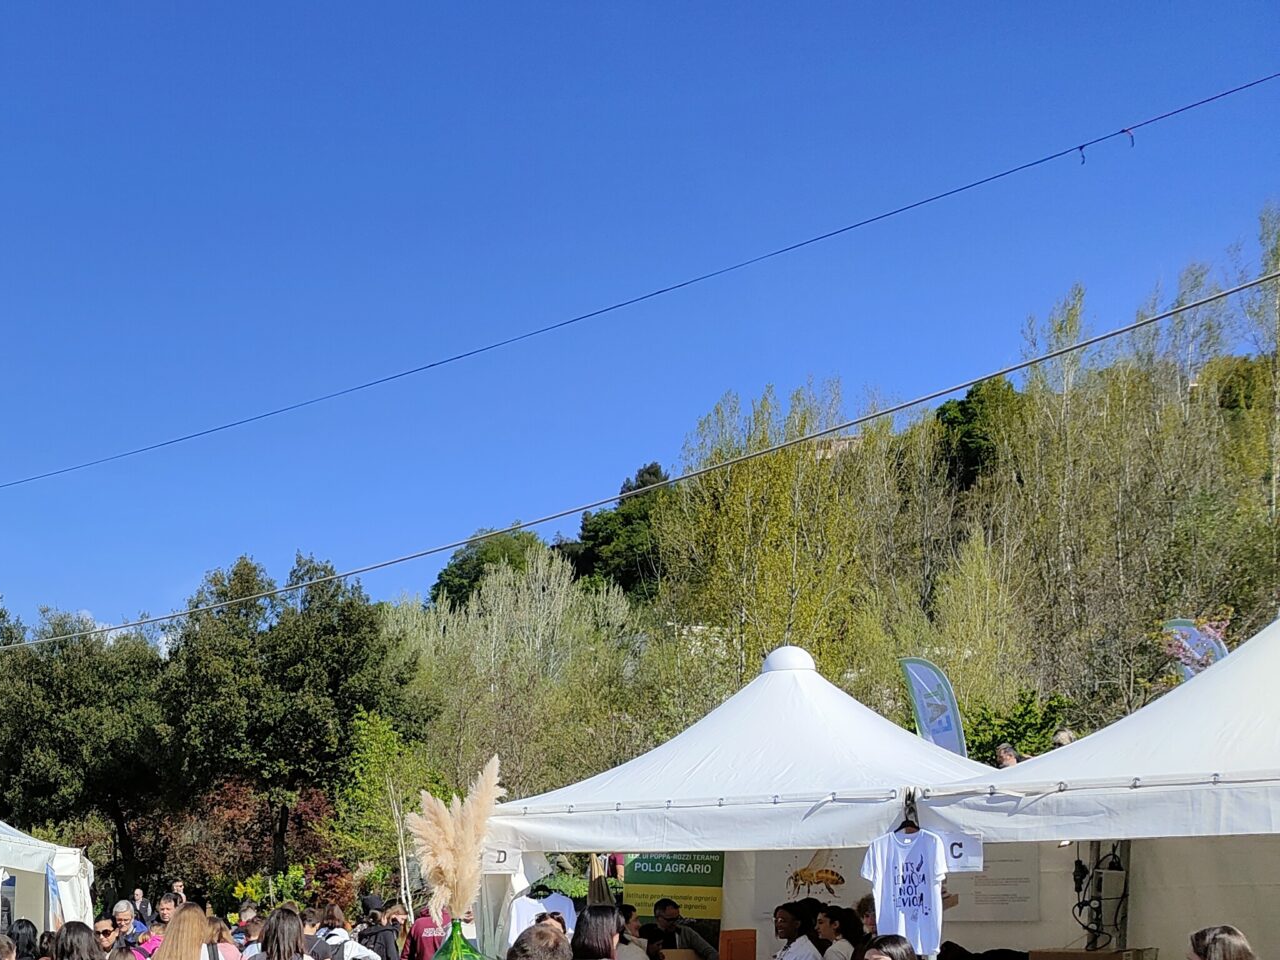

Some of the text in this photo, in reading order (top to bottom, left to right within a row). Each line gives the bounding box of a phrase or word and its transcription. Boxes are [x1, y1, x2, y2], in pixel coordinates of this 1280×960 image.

[949, 842, 963, 859] C
[495, 850, 507, 864] D
[634, 862, 712, 873] POLO AGRARIO
[899, 886, 918, 896] NOT
